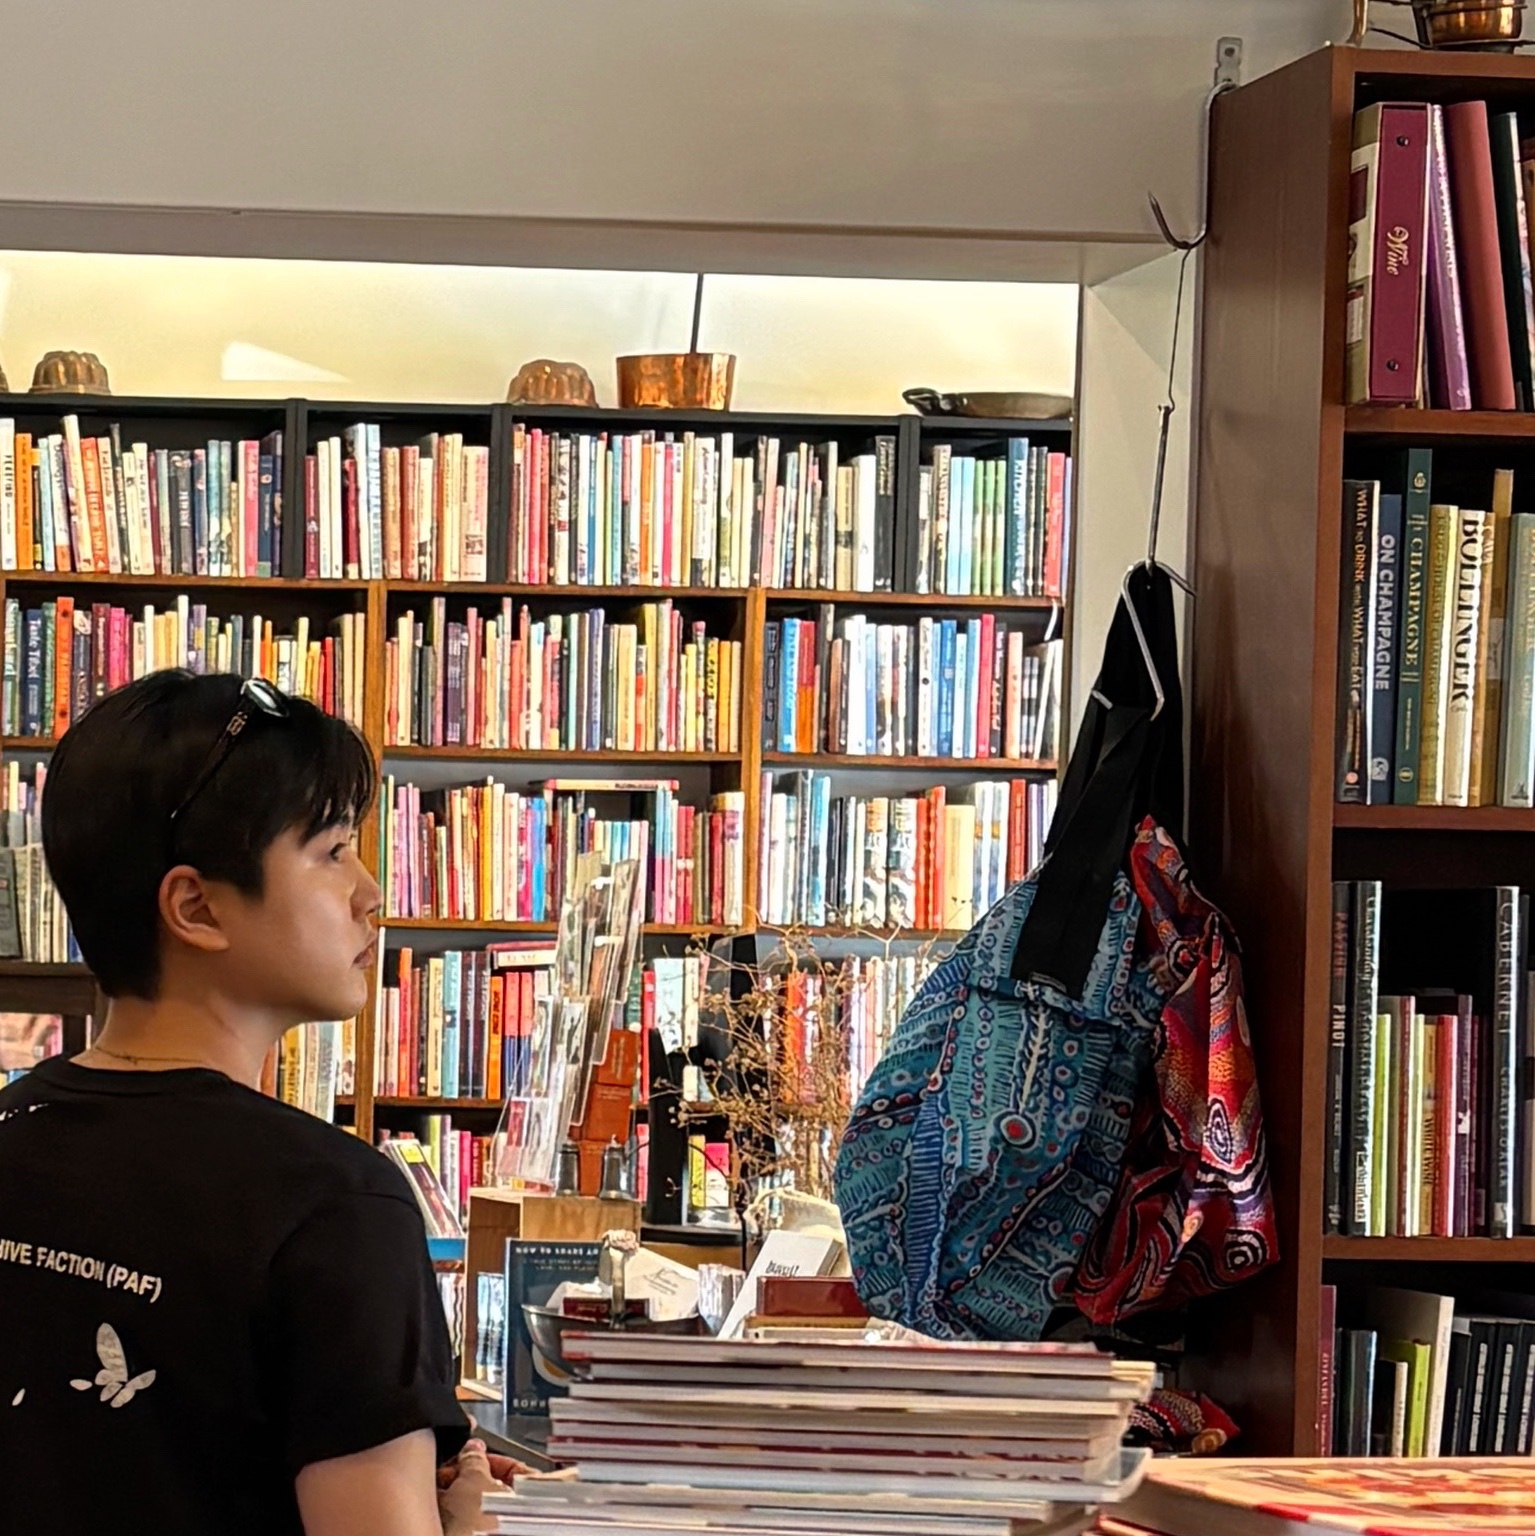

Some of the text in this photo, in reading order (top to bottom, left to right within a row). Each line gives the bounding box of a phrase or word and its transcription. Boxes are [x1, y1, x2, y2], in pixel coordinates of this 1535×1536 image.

[1355, 488, 1367, 529] WHAT
[1353, 544, 1366, 582] DRINK
[1405, 538, 1424, 666] CHAMPAGNE
[1352, 606, 1365, 644] WHAT
[1375, 533, 1396, 690] ON CHAMPAGNE
[1451, 519, 1482, 704] BOLLINGER
[1497, 902, 1512, 1034] CABERNET
[35, 1246, 106, 1282] FACTION
[106, 1263, 163, 1304] (PAF)
